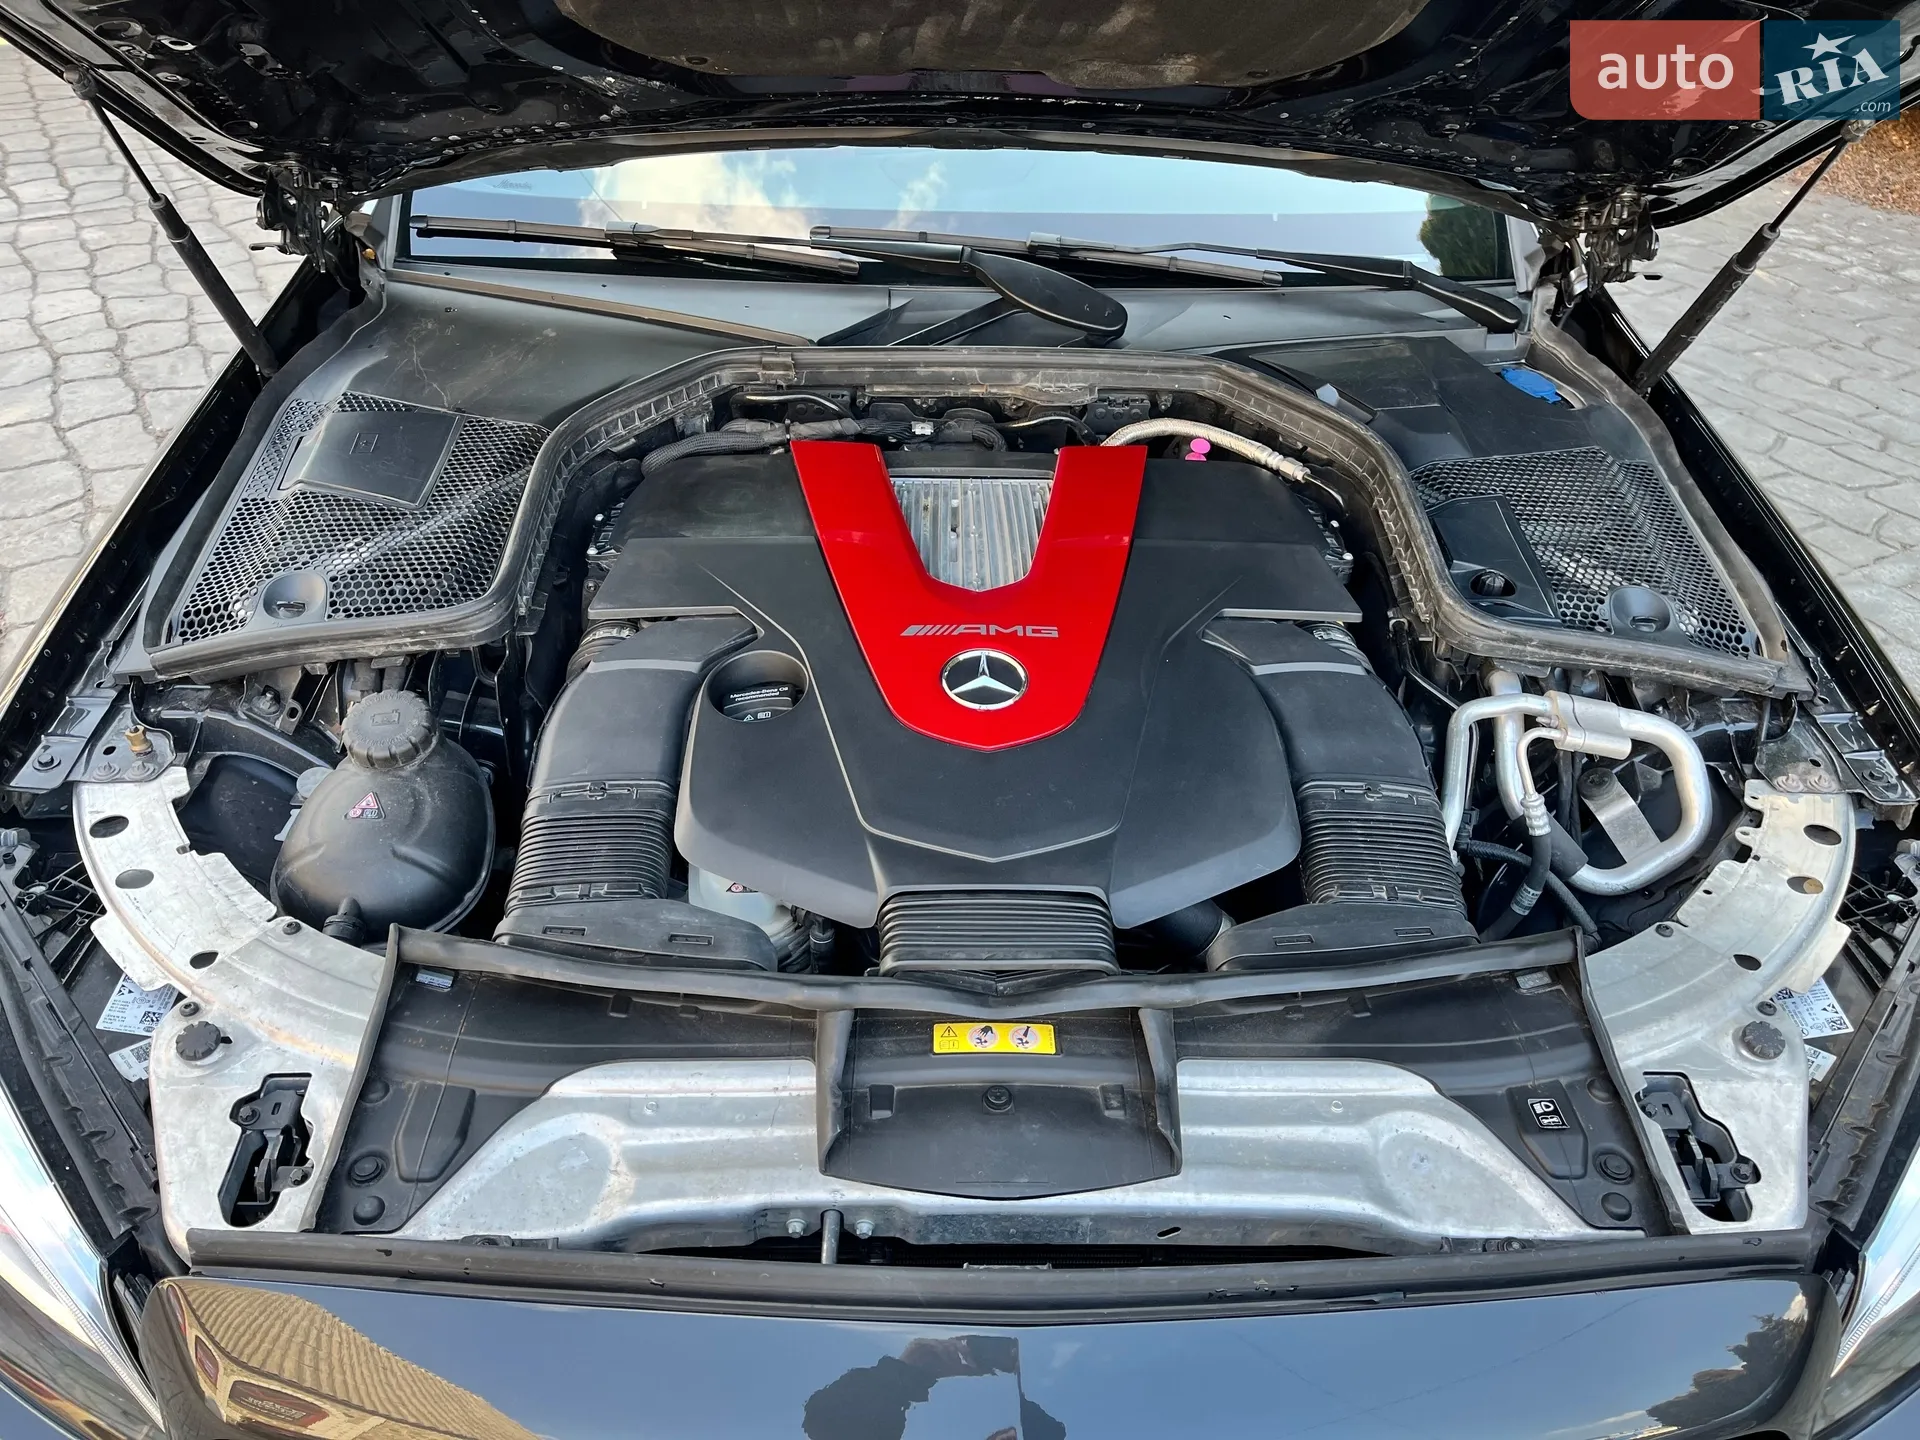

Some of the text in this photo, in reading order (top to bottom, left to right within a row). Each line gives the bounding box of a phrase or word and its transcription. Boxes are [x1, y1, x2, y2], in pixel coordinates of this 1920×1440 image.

[951, 623, 1059, 638] AMG
[729, 688, 778, 699] Mercedes-Benz
[735, 691, 780, 702] recommended
